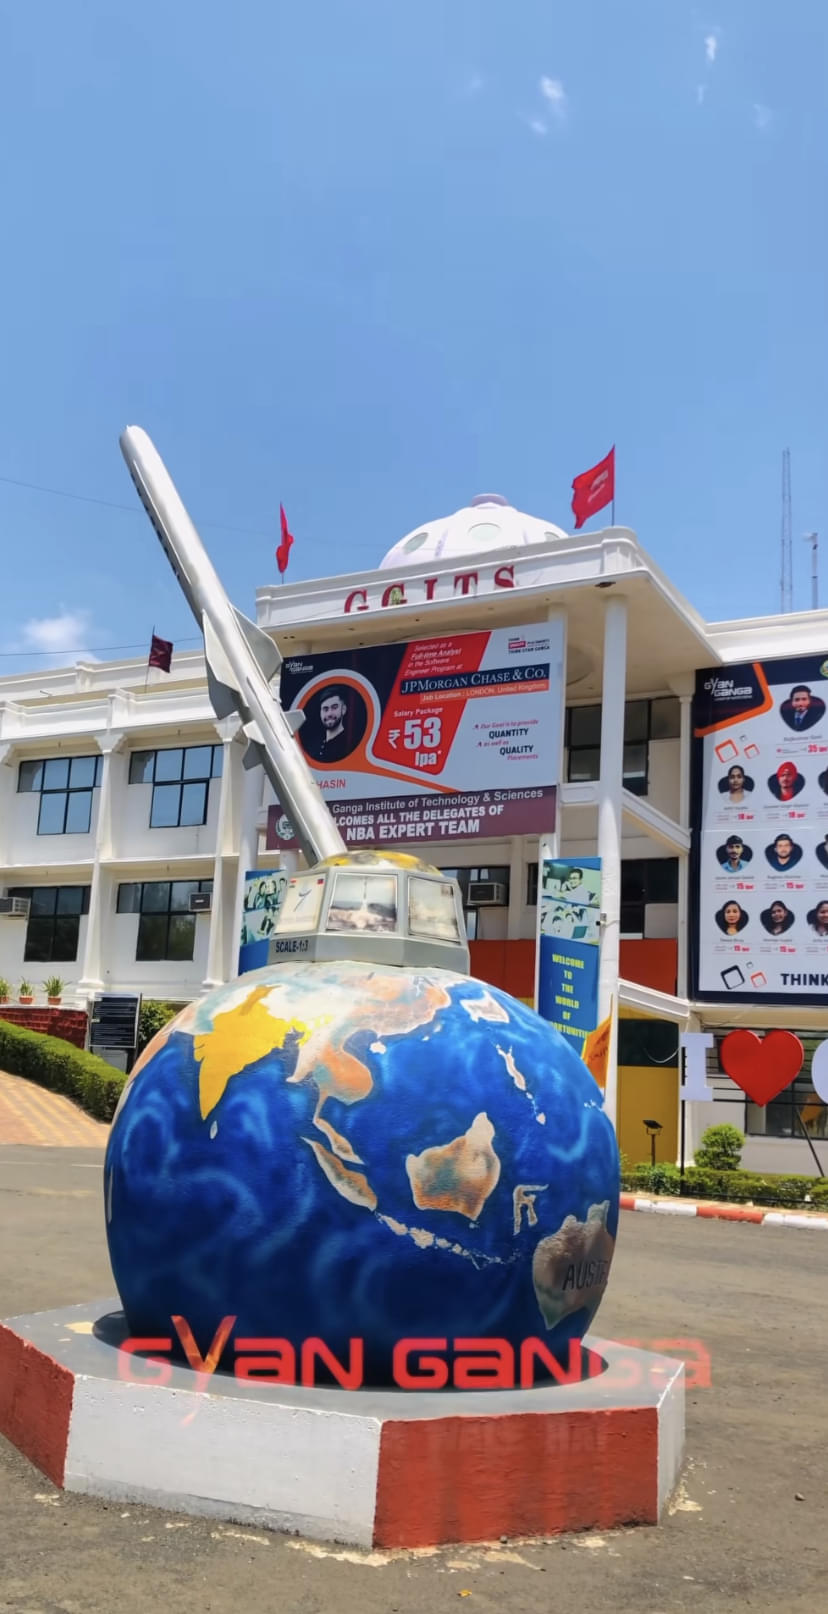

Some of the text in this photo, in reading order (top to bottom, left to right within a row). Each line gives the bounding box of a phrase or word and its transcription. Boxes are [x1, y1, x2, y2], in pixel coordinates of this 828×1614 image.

[439, 648, 462, 656] Analyst
[512, 669, 523, 681] &
[435, 692, 461, 700] Location
[519, 683, 545, 691] Kingdom
[394, 707, 443, 718] Salary Package
[404, 716, 442, 750] 53
[489, 728, 529, 739] QUANTITY
[499, 745, 534, 756] QUALITY
[333, 803, 363, 814] Ganga
[366, 799, 406, 811] Institute
[408, 797, 419, 808] of
[421, 794, 480, 807] Technology
[483, 792, 491, 802] &
[494, 789, 544, 801] Sciences
[377, 813, 396, 825] ALL
[399, 810, 420, 823] THE
[423, 806, 486, 821] DELEGATES
[489, 805, 504, 816] OF
[347, 819, 480, 840] NBA EXPERT TEAM
[552, 953, 585, 970] WELCOME
[563, 969, 573, 980] TO
[780, 973, 828, 986] THINK
[561, 982, 574, 994] THE
[554, 994, 580, 1009] WORLD
[562, 1010, 571, 1021] OF
[680, 1032, 714, 1102] I
